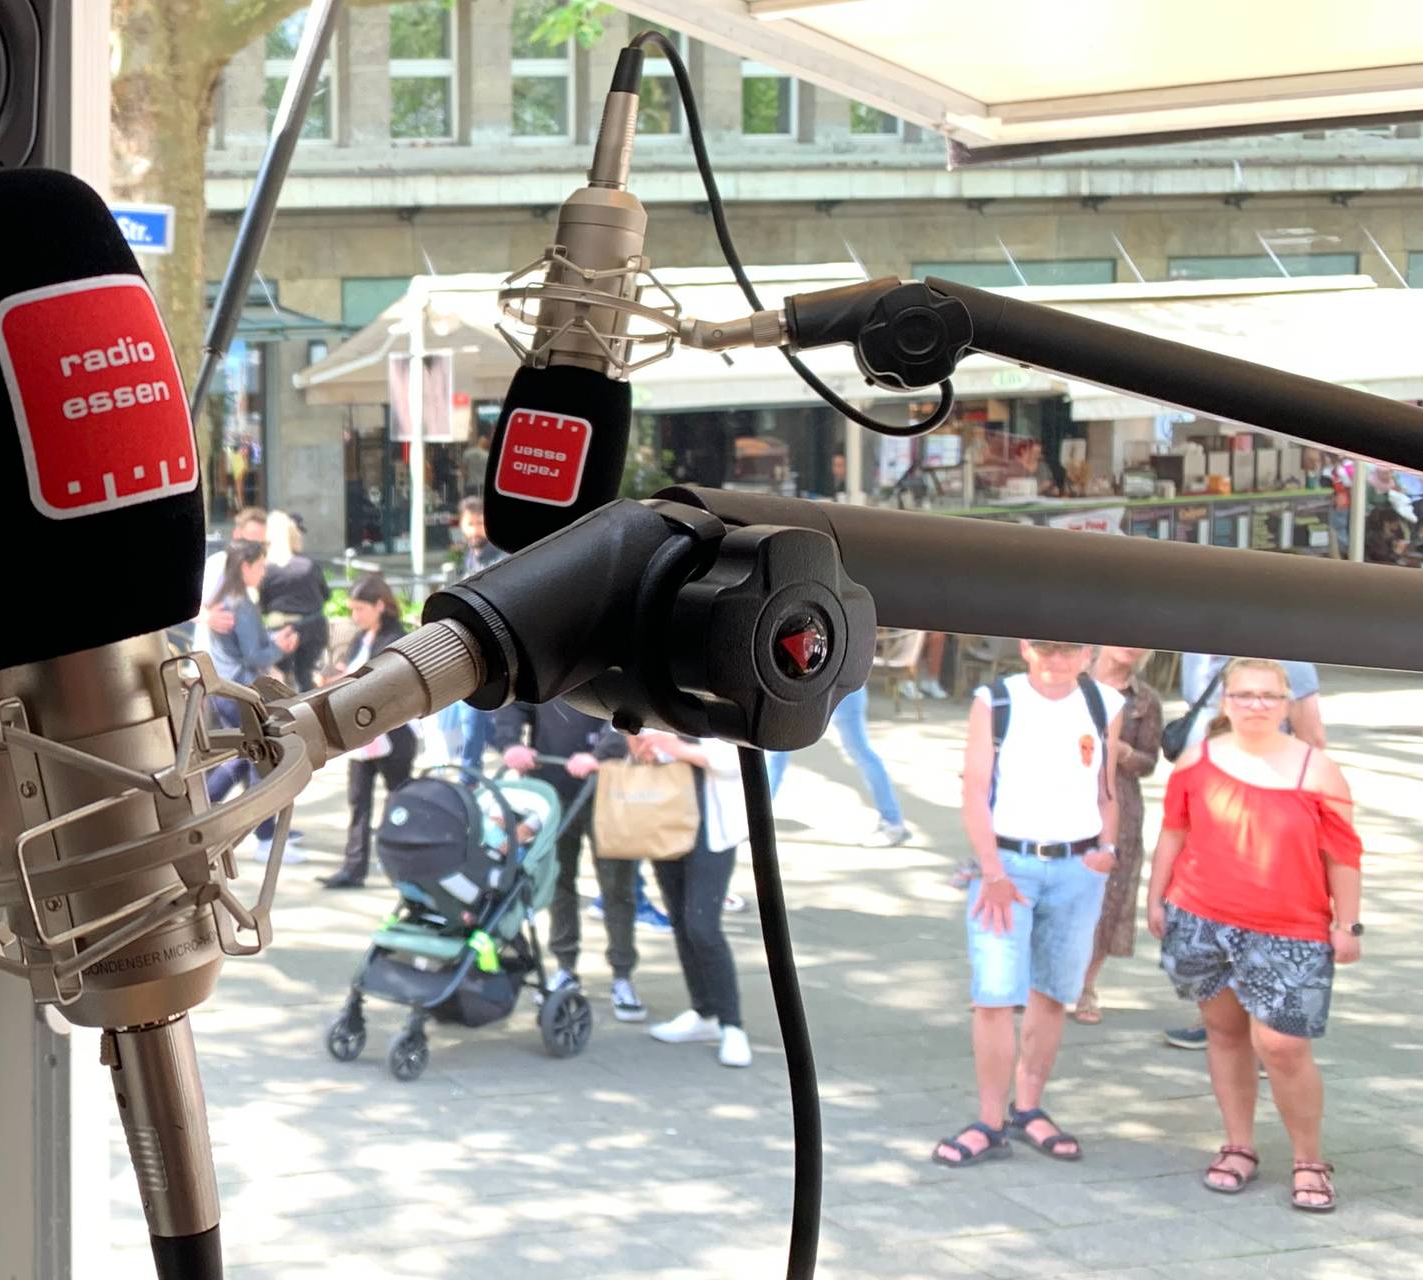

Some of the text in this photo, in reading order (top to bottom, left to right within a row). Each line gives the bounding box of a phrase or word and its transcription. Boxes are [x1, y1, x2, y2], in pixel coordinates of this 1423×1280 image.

[60, 336, 156, 377] radio
[62, 381, 170, 420] essen
[513, 445, 567, 462] essen
[513, 461, 560, 478] radio
